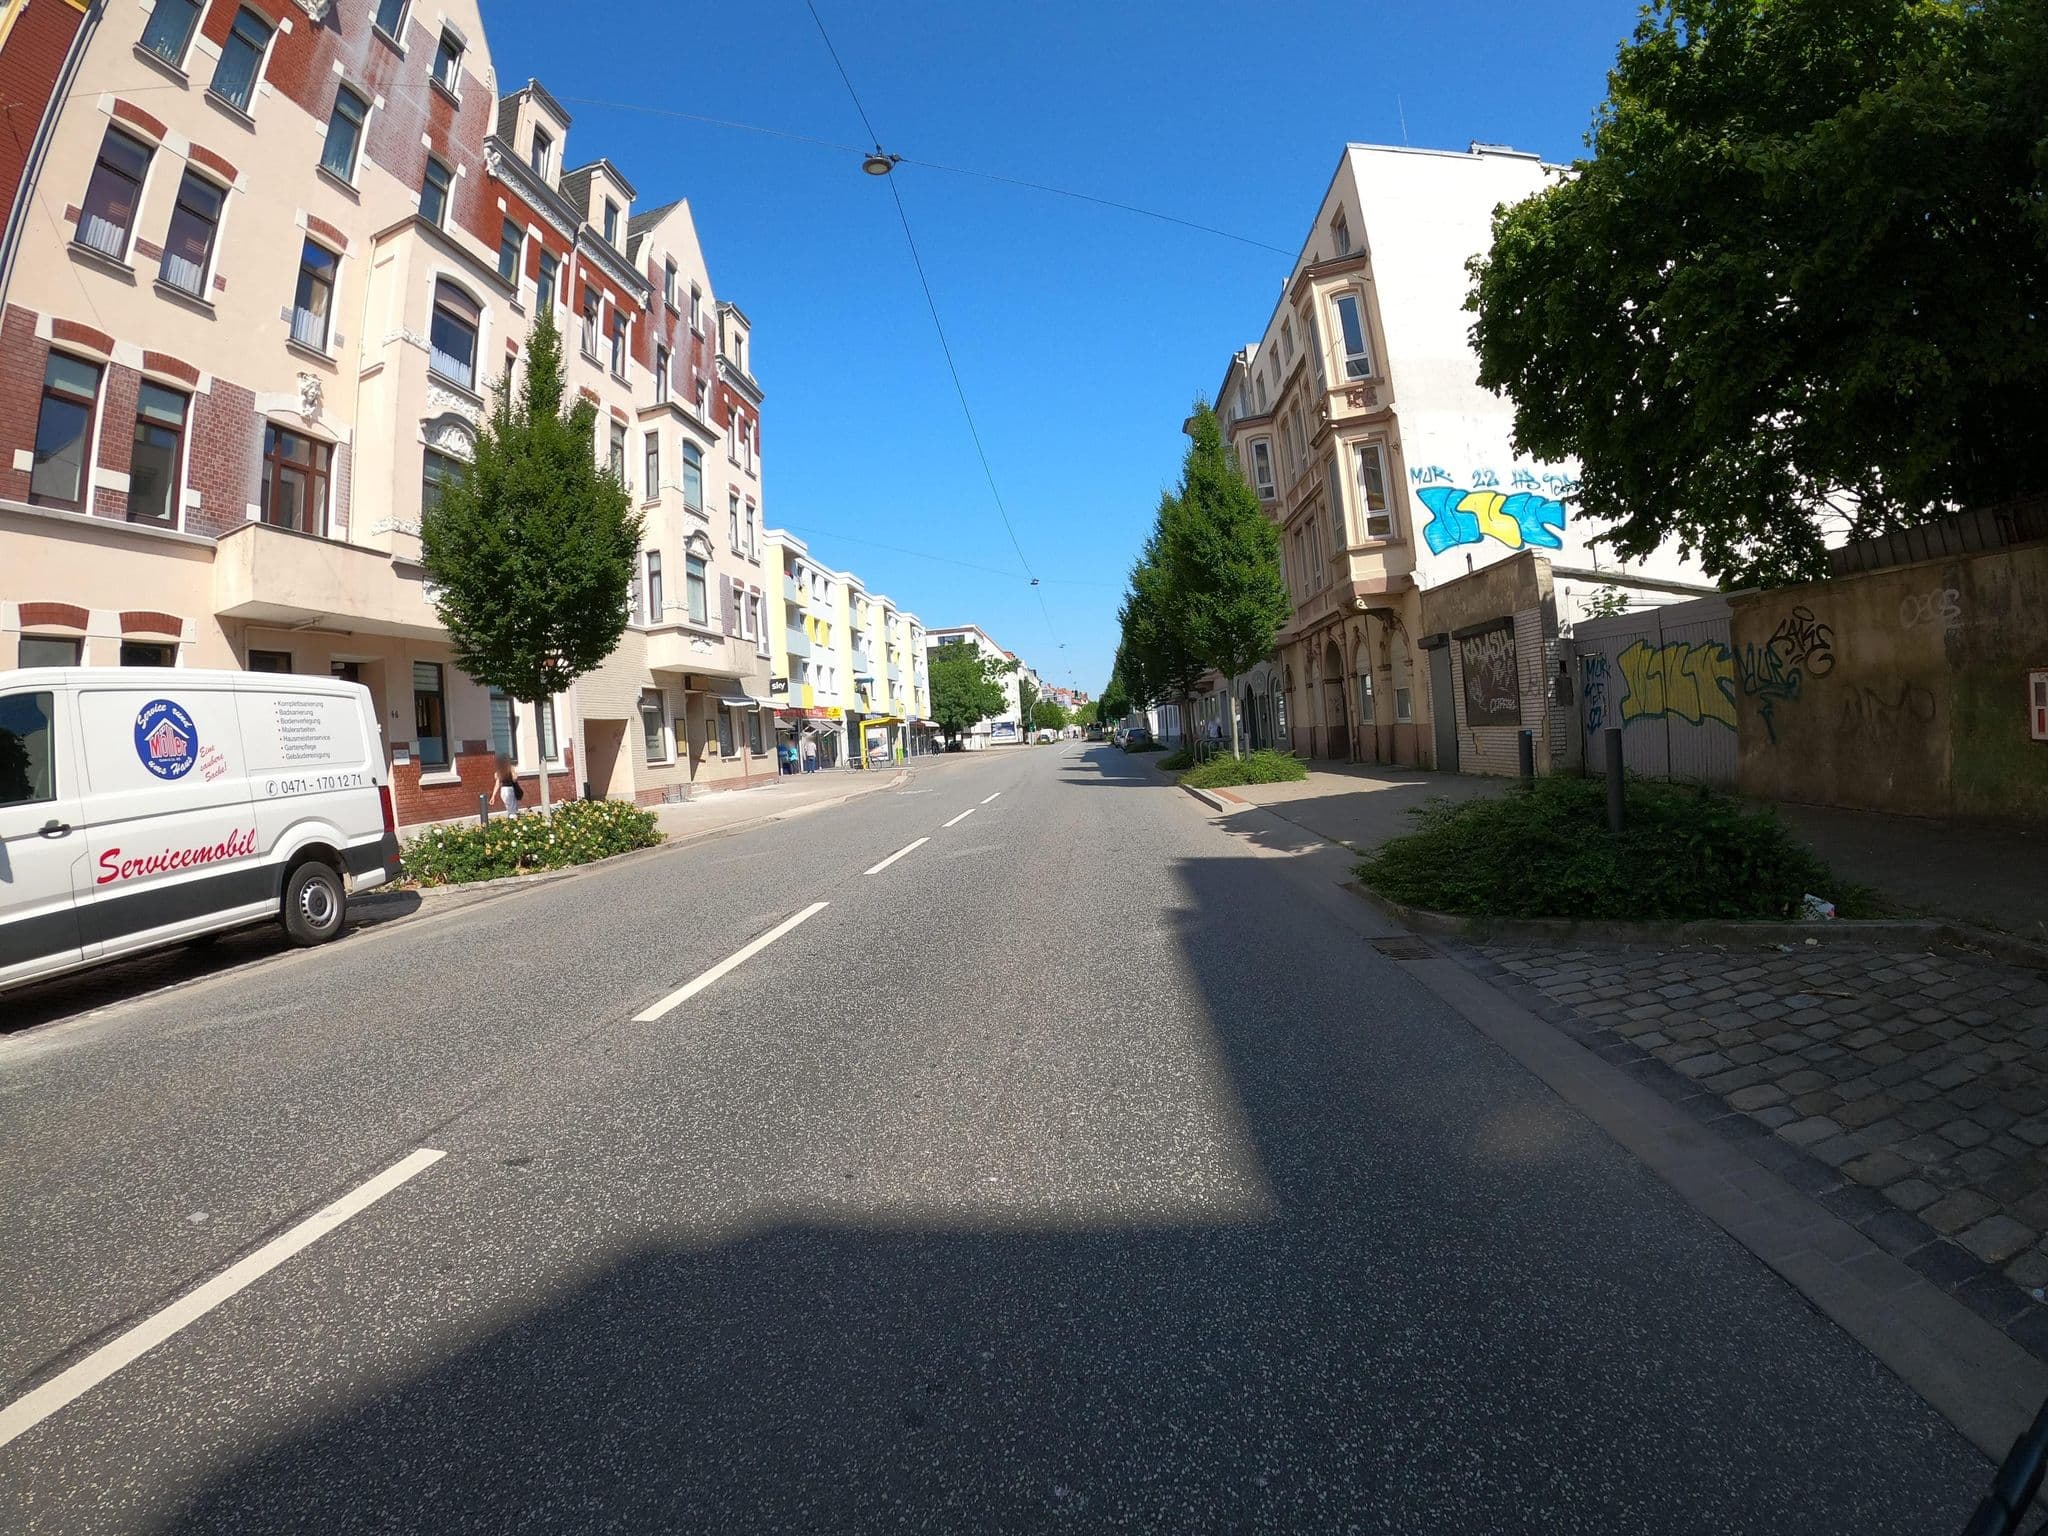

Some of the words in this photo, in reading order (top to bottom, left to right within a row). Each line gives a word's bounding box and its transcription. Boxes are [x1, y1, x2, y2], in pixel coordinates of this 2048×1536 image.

[771, 681, 786, 691] sky
[137, 704, 167, 729] Service
[170, 756, 192, 776] Haus
[281, 779, 307, 793] 0471
[316, 776, 335, 789] 170
[337, 774, 349, 788] 12
[351, 774, 362, 786] 71
[97, 828, 257, 884] Servicemobil
